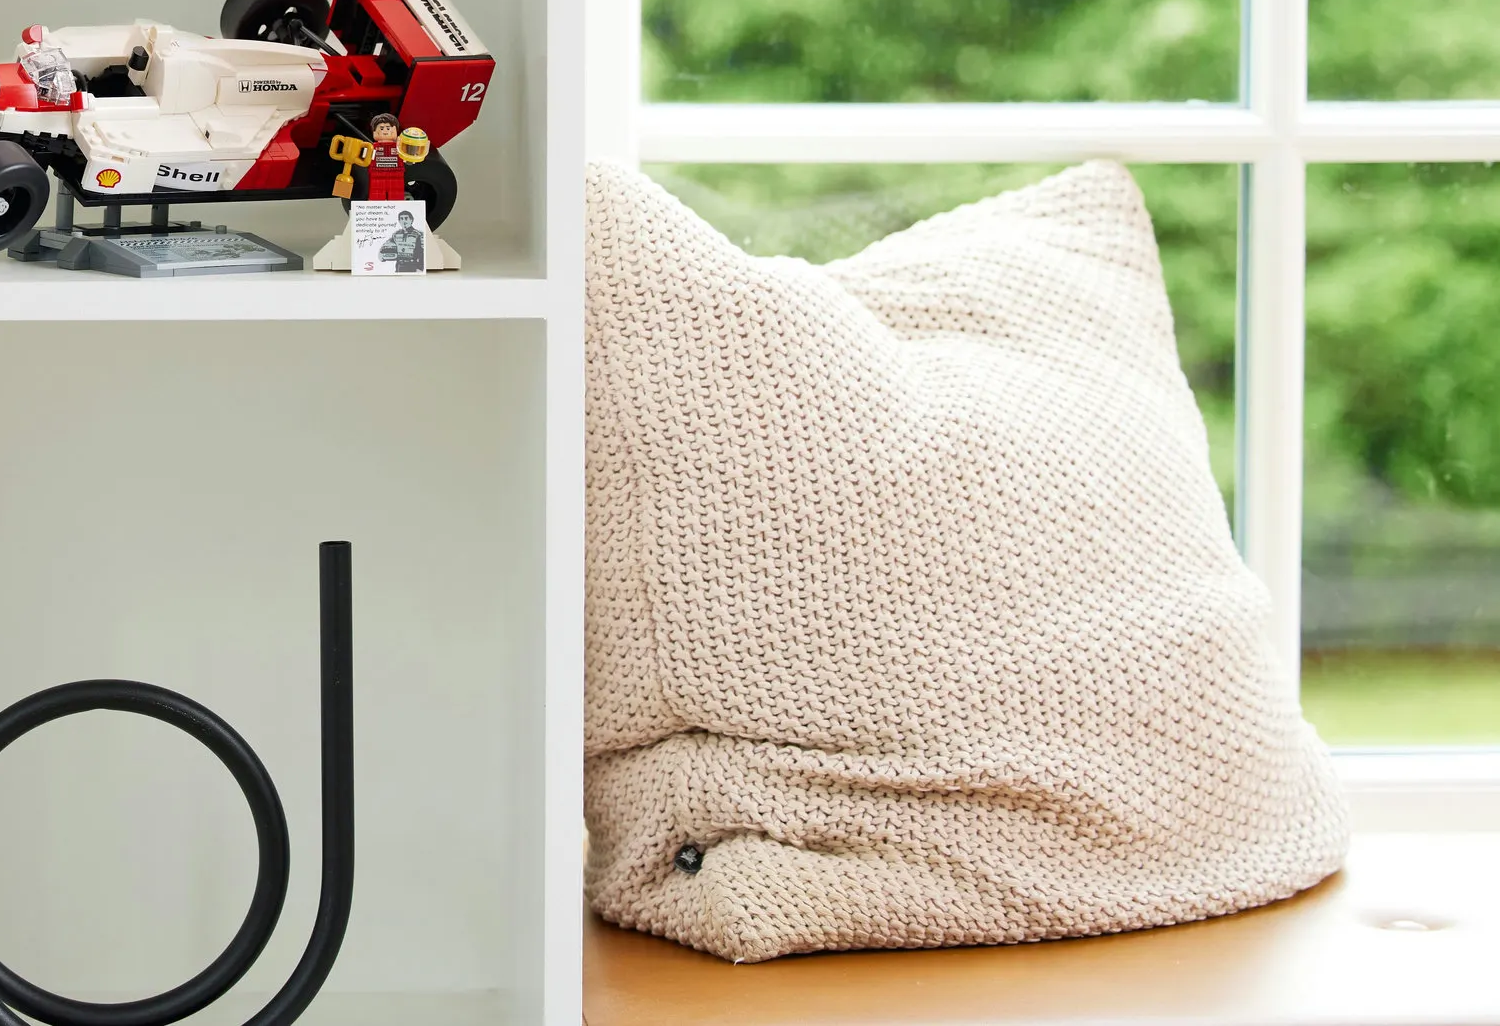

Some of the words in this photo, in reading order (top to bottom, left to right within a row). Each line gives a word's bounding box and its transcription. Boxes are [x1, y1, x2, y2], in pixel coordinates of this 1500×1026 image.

[253, 84, 298, 92] HONDA
[460, 82, 485, 102] 12
[156, 164, 220, 183] Shell
